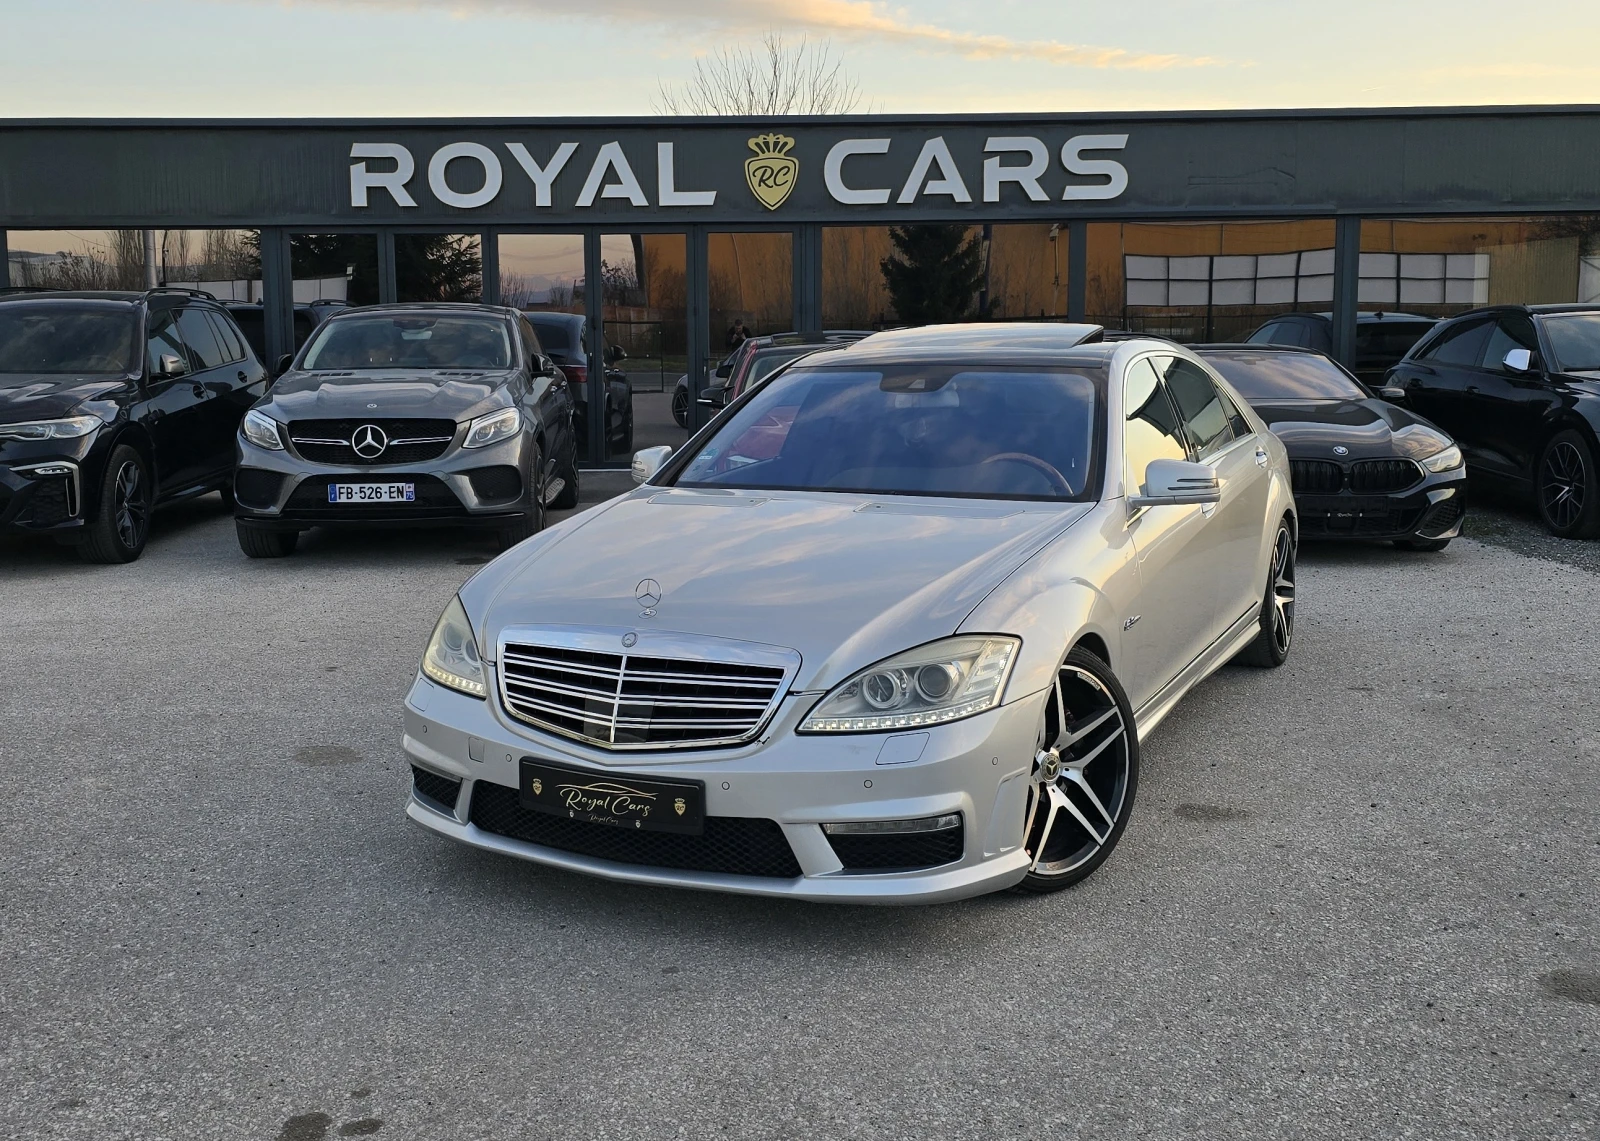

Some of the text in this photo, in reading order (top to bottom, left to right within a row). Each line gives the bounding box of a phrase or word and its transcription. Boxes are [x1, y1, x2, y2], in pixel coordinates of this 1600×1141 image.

[350, 134, 1130, 208] ROYAL CARS
[752, 165, 791, 188] RC
[338, 485, 405, 500] FB-526-EN
[406, 491, 413, 499] 75
[560, 787, 652, 817] Royal Cars
